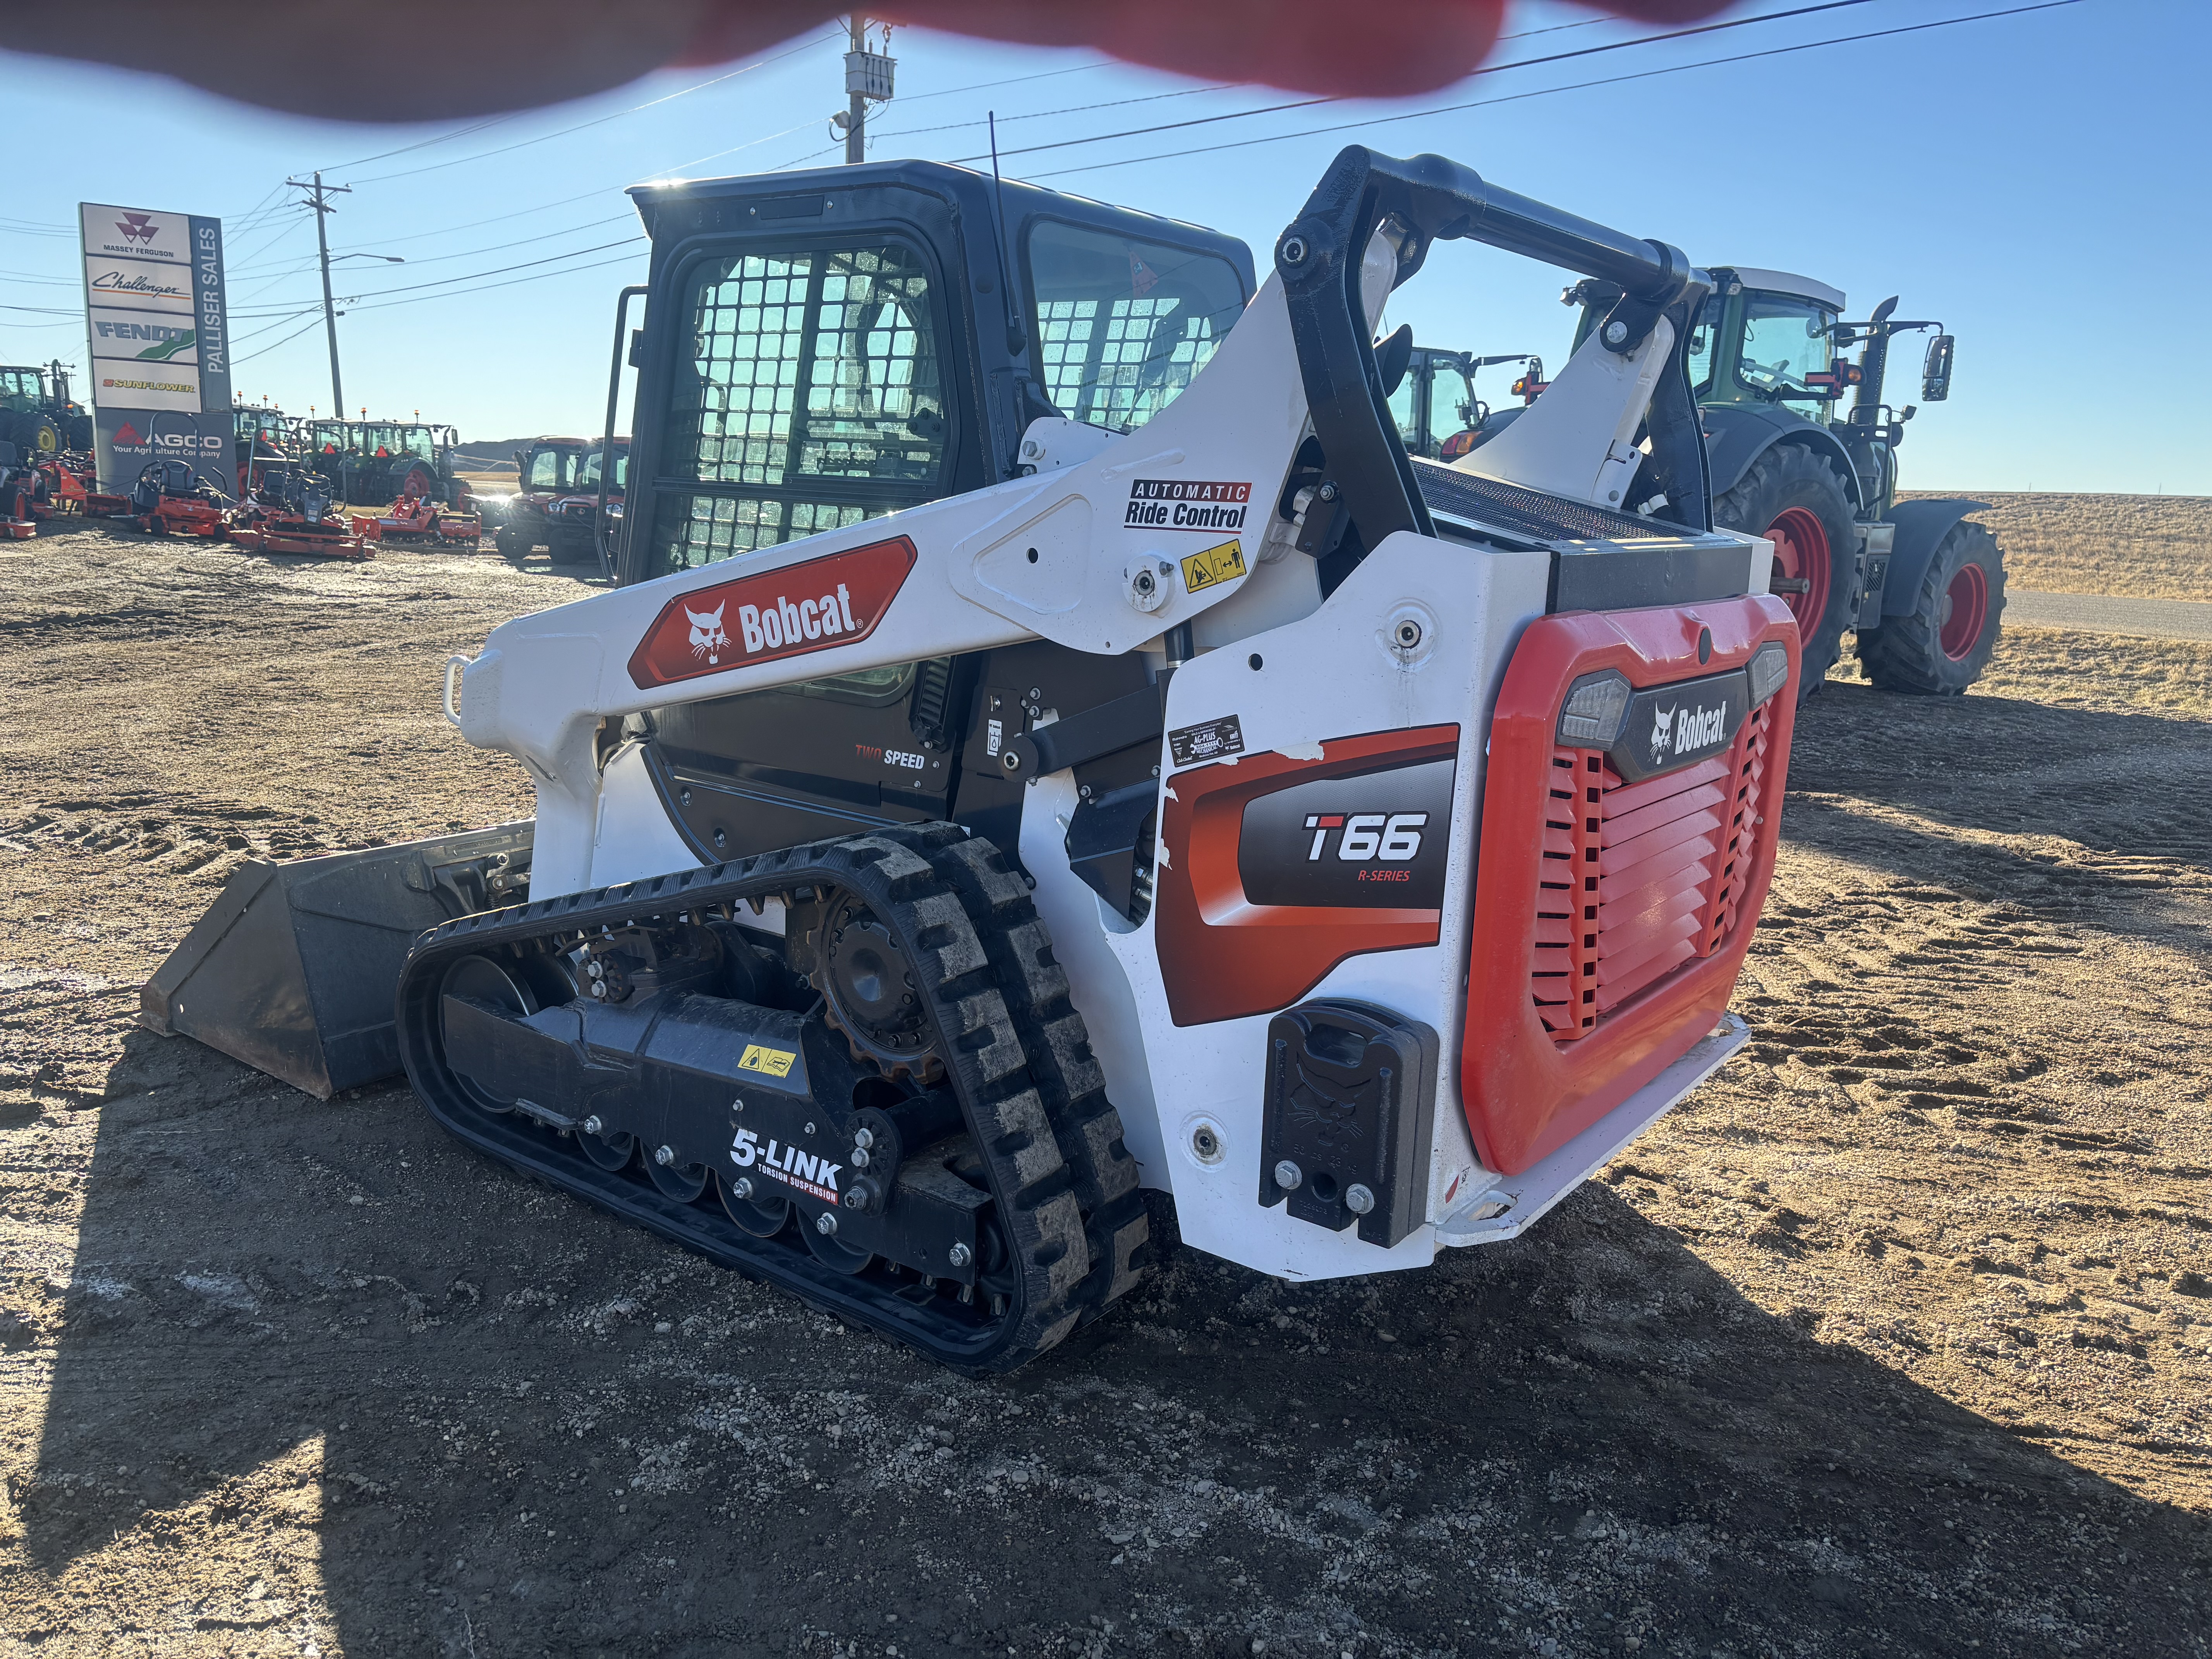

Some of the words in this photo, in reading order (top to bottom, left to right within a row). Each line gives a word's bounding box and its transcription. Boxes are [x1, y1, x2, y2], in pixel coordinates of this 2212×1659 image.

[103, 244, 134, 252] MASSEY
[136, 247, 174, 257] FERGUSON
[199, 228, 218, 286] SALES
[92, 271, 191, 298] Challenger
[94, 321, 189, 342] FENDT
[203, 291, 224, 373] PALLISER
[113, 379, 194, 392] SUNFLOWER
[134, 446, 180, 455] Agriulture
[145, 433, 222, 449] AGCO
[1135, 483, 1246, 500] AUTOMATIC
[1125, 501, 1168, 525] Ride
[1173, 503, 1247, 529] Control
[738, 583, 855, 653] Bobcat
[1674, 701, 1726, 755] Bobcat
[855, 744, 882, 761] TWO
[884, 749, 925, 769] SPEED
[1305, 813, 1427, 861] T66
[1358, 870, 1410, 882] R-SERIES
[730, 1128, 843, 1191] 5-LINK
[757, 1163, 788, 1183] TORSION
[790, 1176, 836, 1202] SUSPENSION
